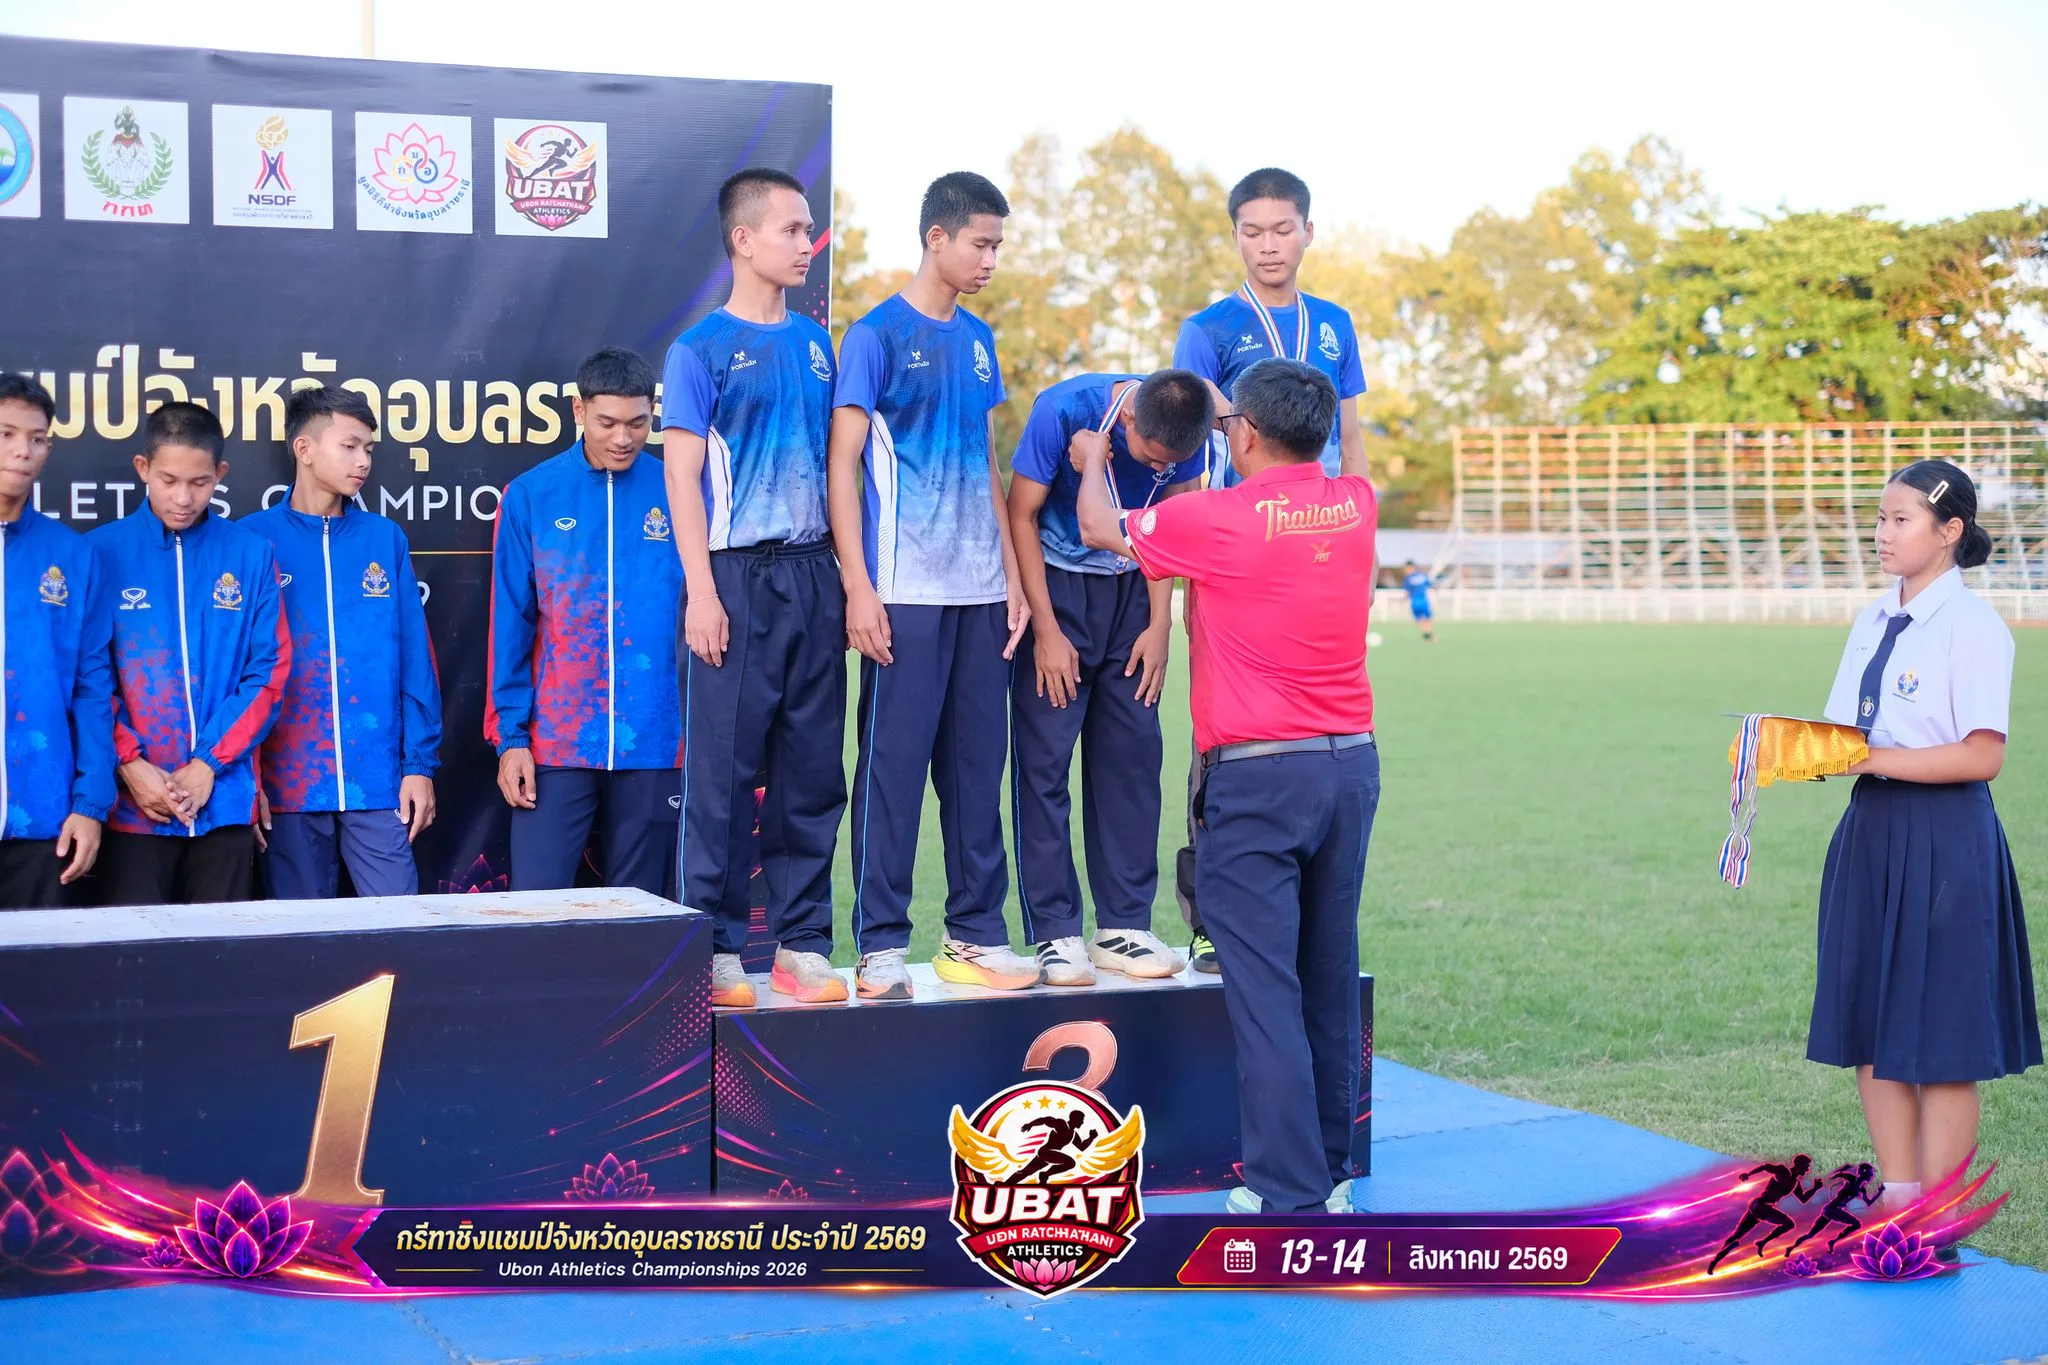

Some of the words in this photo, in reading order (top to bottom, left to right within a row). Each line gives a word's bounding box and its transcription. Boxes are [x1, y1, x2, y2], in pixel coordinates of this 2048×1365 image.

[248, 193, 297, 206] NSDF
[513, 178, 592, 201] UBAT
[102, 200, 154, 217] กกท
[533, 207, 571, 215] ATHLETICS
[1255, 492, 1361, 542] Thailand
[276, 974, 395, 1208] 1
